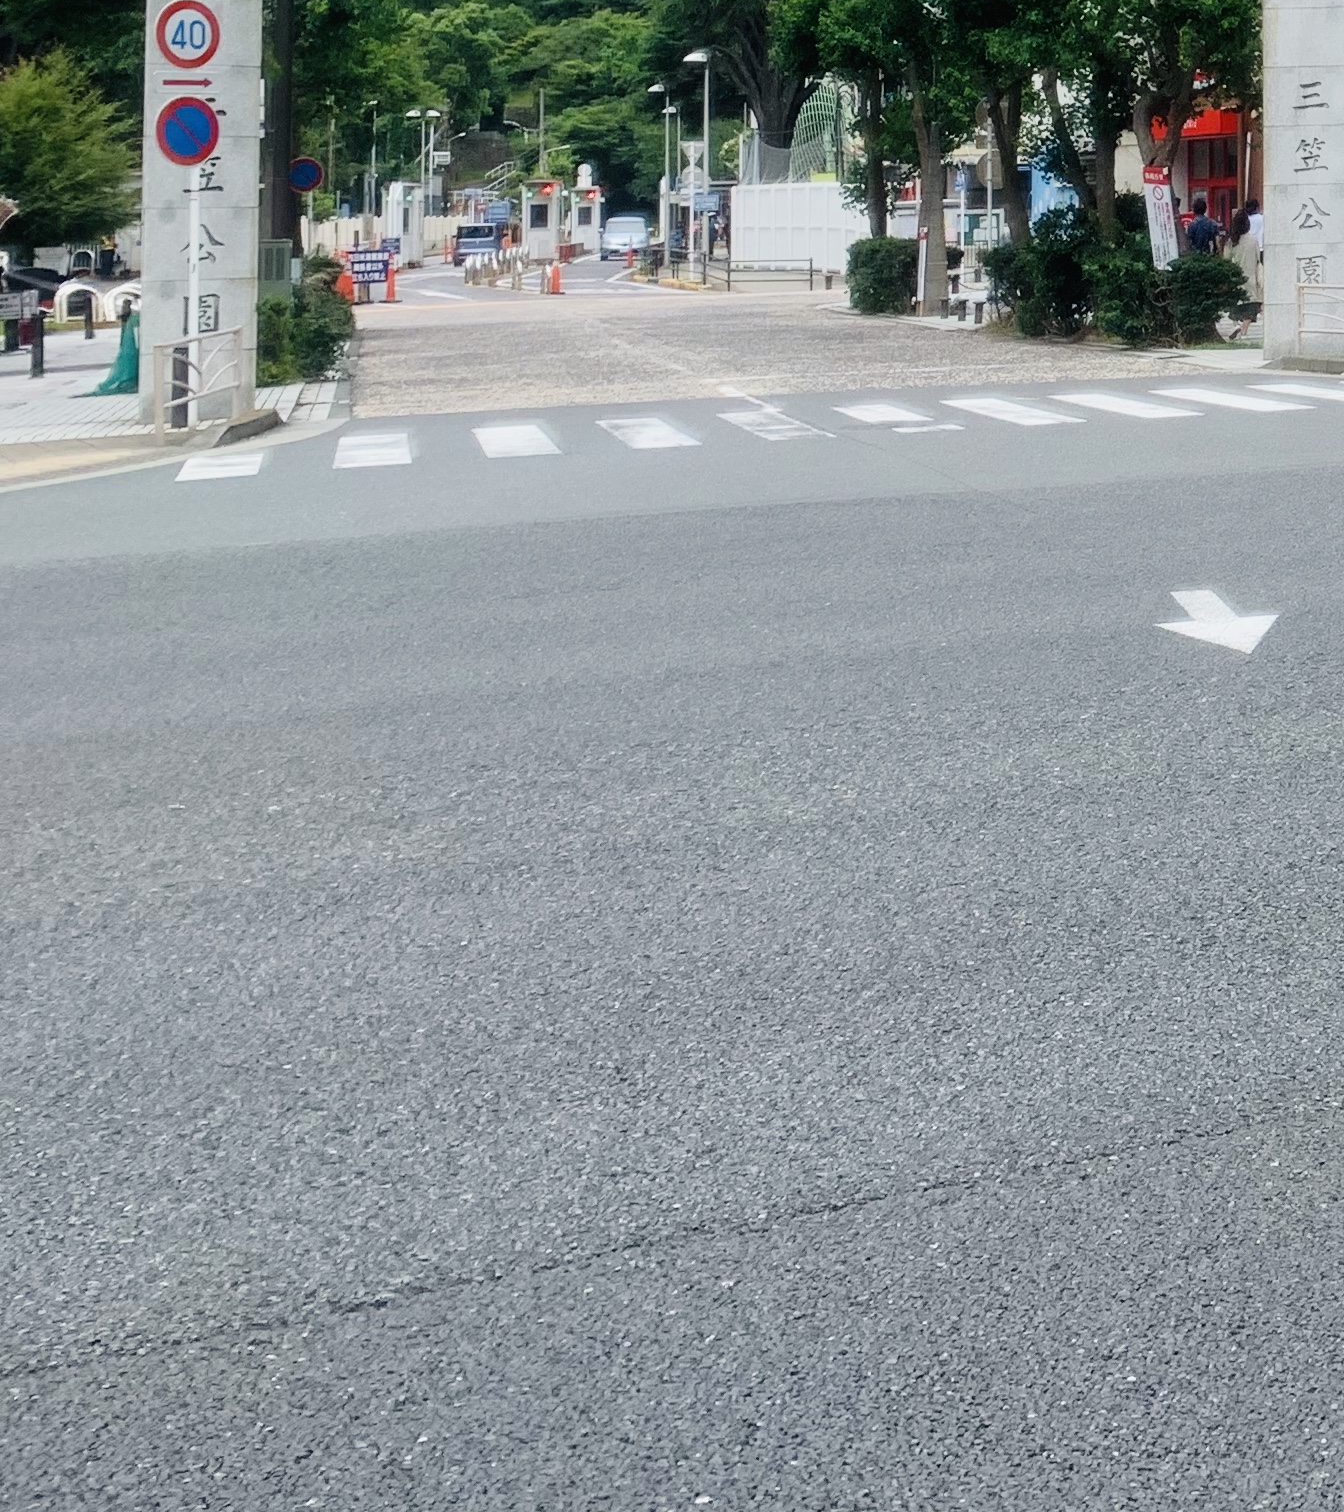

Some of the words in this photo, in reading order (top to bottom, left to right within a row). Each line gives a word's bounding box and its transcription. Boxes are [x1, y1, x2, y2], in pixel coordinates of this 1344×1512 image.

[171, 19, 206, 50] 40
[1292, 80, 1331, 290] 三笠公園
